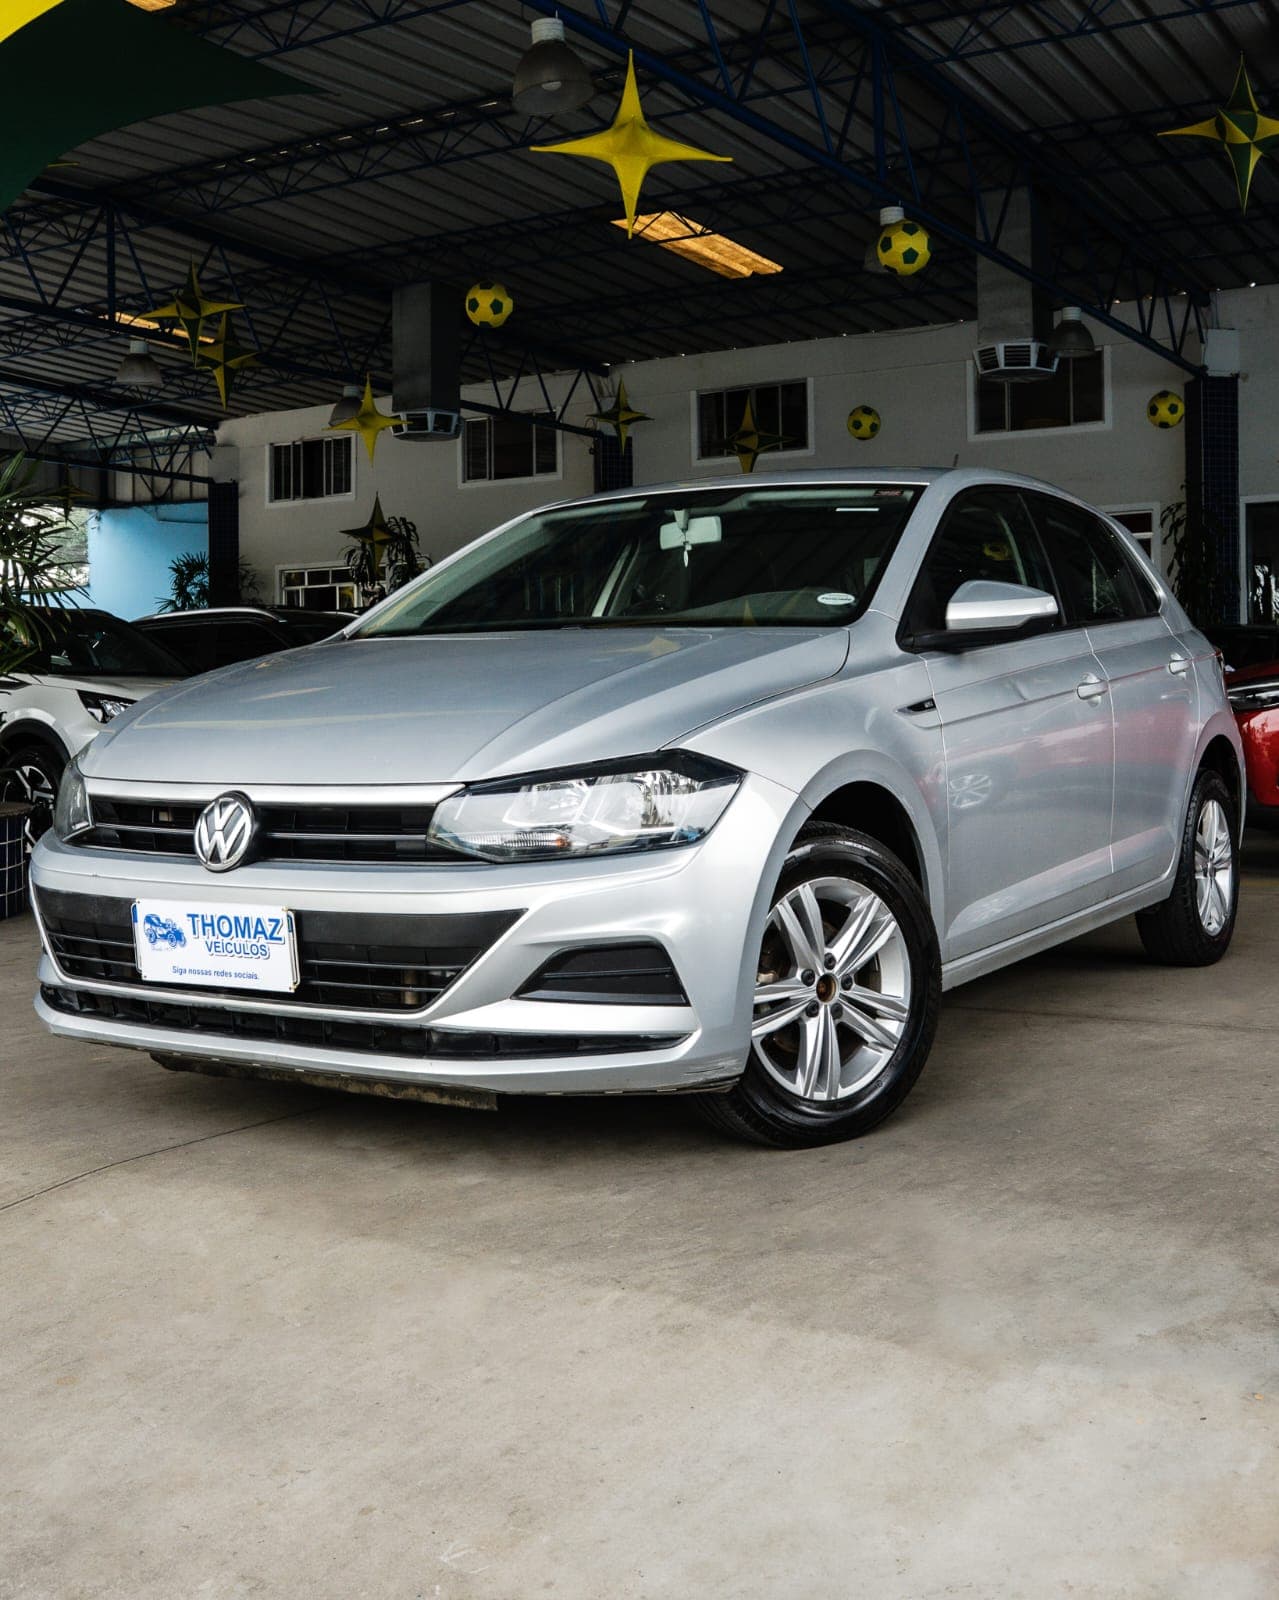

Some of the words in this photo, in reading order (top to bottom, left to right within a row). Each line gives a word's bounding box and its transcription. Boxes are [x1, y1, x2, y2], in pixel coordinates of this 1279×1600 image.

[187, 913, 283, 941] THOMAZ
[172, 965, 187, 976] Siga
[188, 967, 212, 976] nossas
[213, 969, 233, 978] redes
